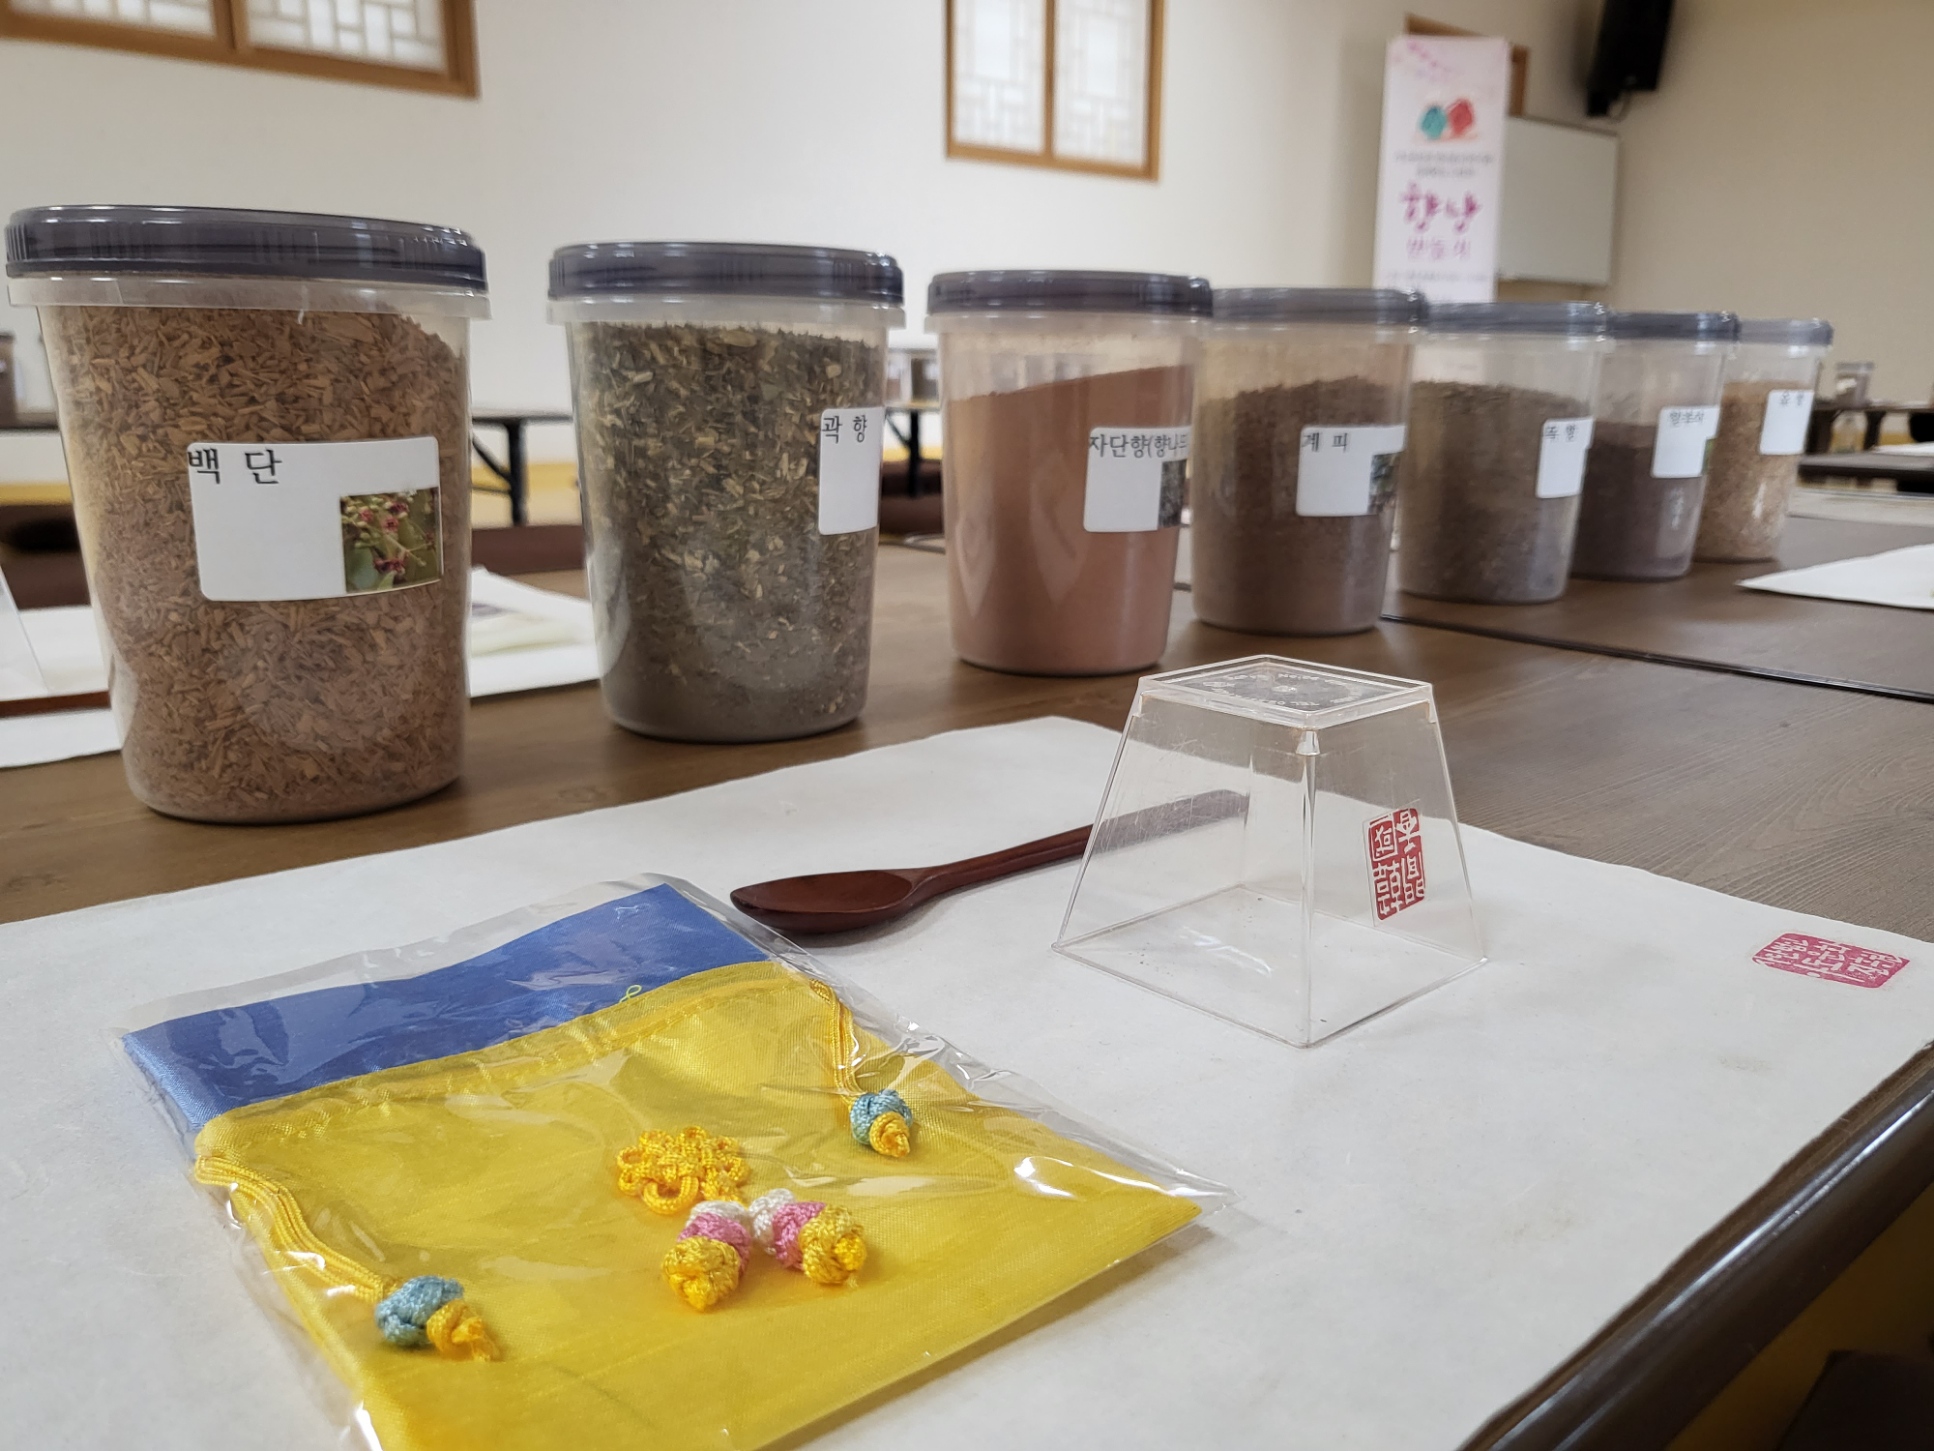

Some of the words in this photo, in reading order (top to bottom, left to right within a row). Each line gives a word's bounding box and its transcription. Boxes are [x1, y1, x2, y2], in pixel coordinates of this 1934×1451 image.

[821, 415, 843, 444] 곽
[853, 414, 868, 443] 향
[1301, 431, 1320, 453] 계
[1331, 432, 1348, 454] 피
[187, 448, 221, 485] 백
[245, 448, 283, 485] 단
